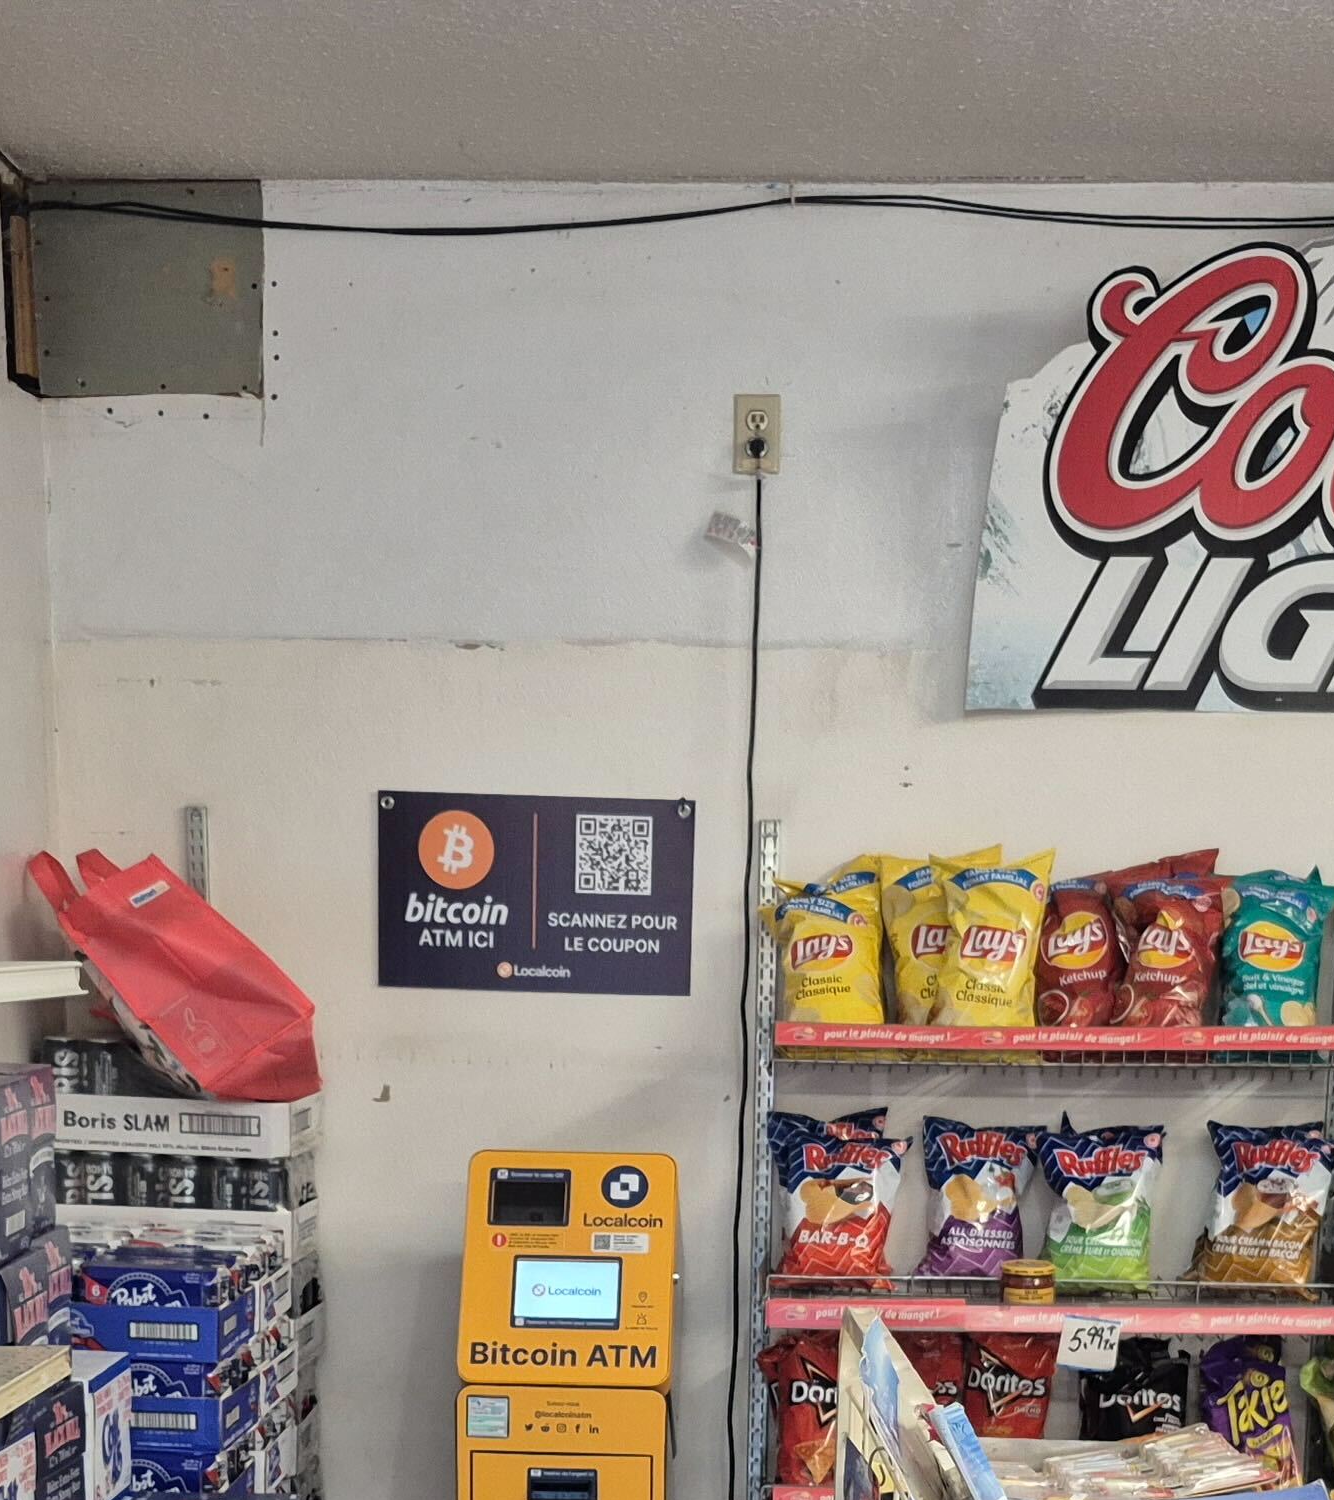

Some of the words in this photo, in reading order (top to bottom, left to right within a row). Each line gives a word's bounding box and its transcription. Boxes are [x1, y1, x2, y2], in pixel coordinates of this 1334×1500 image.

[405, 893, 508, 925] bitcoin
[547, 912, 627, 931] SCANNEZ
[631, 914, 678, 931] POUR
[418, 930, 463, 949] ATM
[468, 931, 494, 948] ICI
[565, 937, 584, 952] LE
[587, 937, 660, 955] COUPON
[513, 964, 571, 980] Localcoin
[802, 976, 842, 986] Classic
[1059, 969, 1107, 986] Ketchup
[796, 986, 850, 1000] Classique
[63, 1110, 117, 1130] Boris
[124, 1114, 170, 1132] SLAM
[805, 1145, 890, 1172] Ruffles
[940, 1133, 1026, 1168] Ruffles
[1233, 1140, 1320, 1171] Ruffles
[1057, 1148, 1145, 1178] Ruffles
[583, 1213, 663, 1228] Localcoin
[799, 1231, 868, 1247] BAR-B-Q
[470, 1341, 577, 1367] Bitcoin
[586, 1344, 656, 1368] ATM
[968, 1371, 1045, 1404] Doritos
